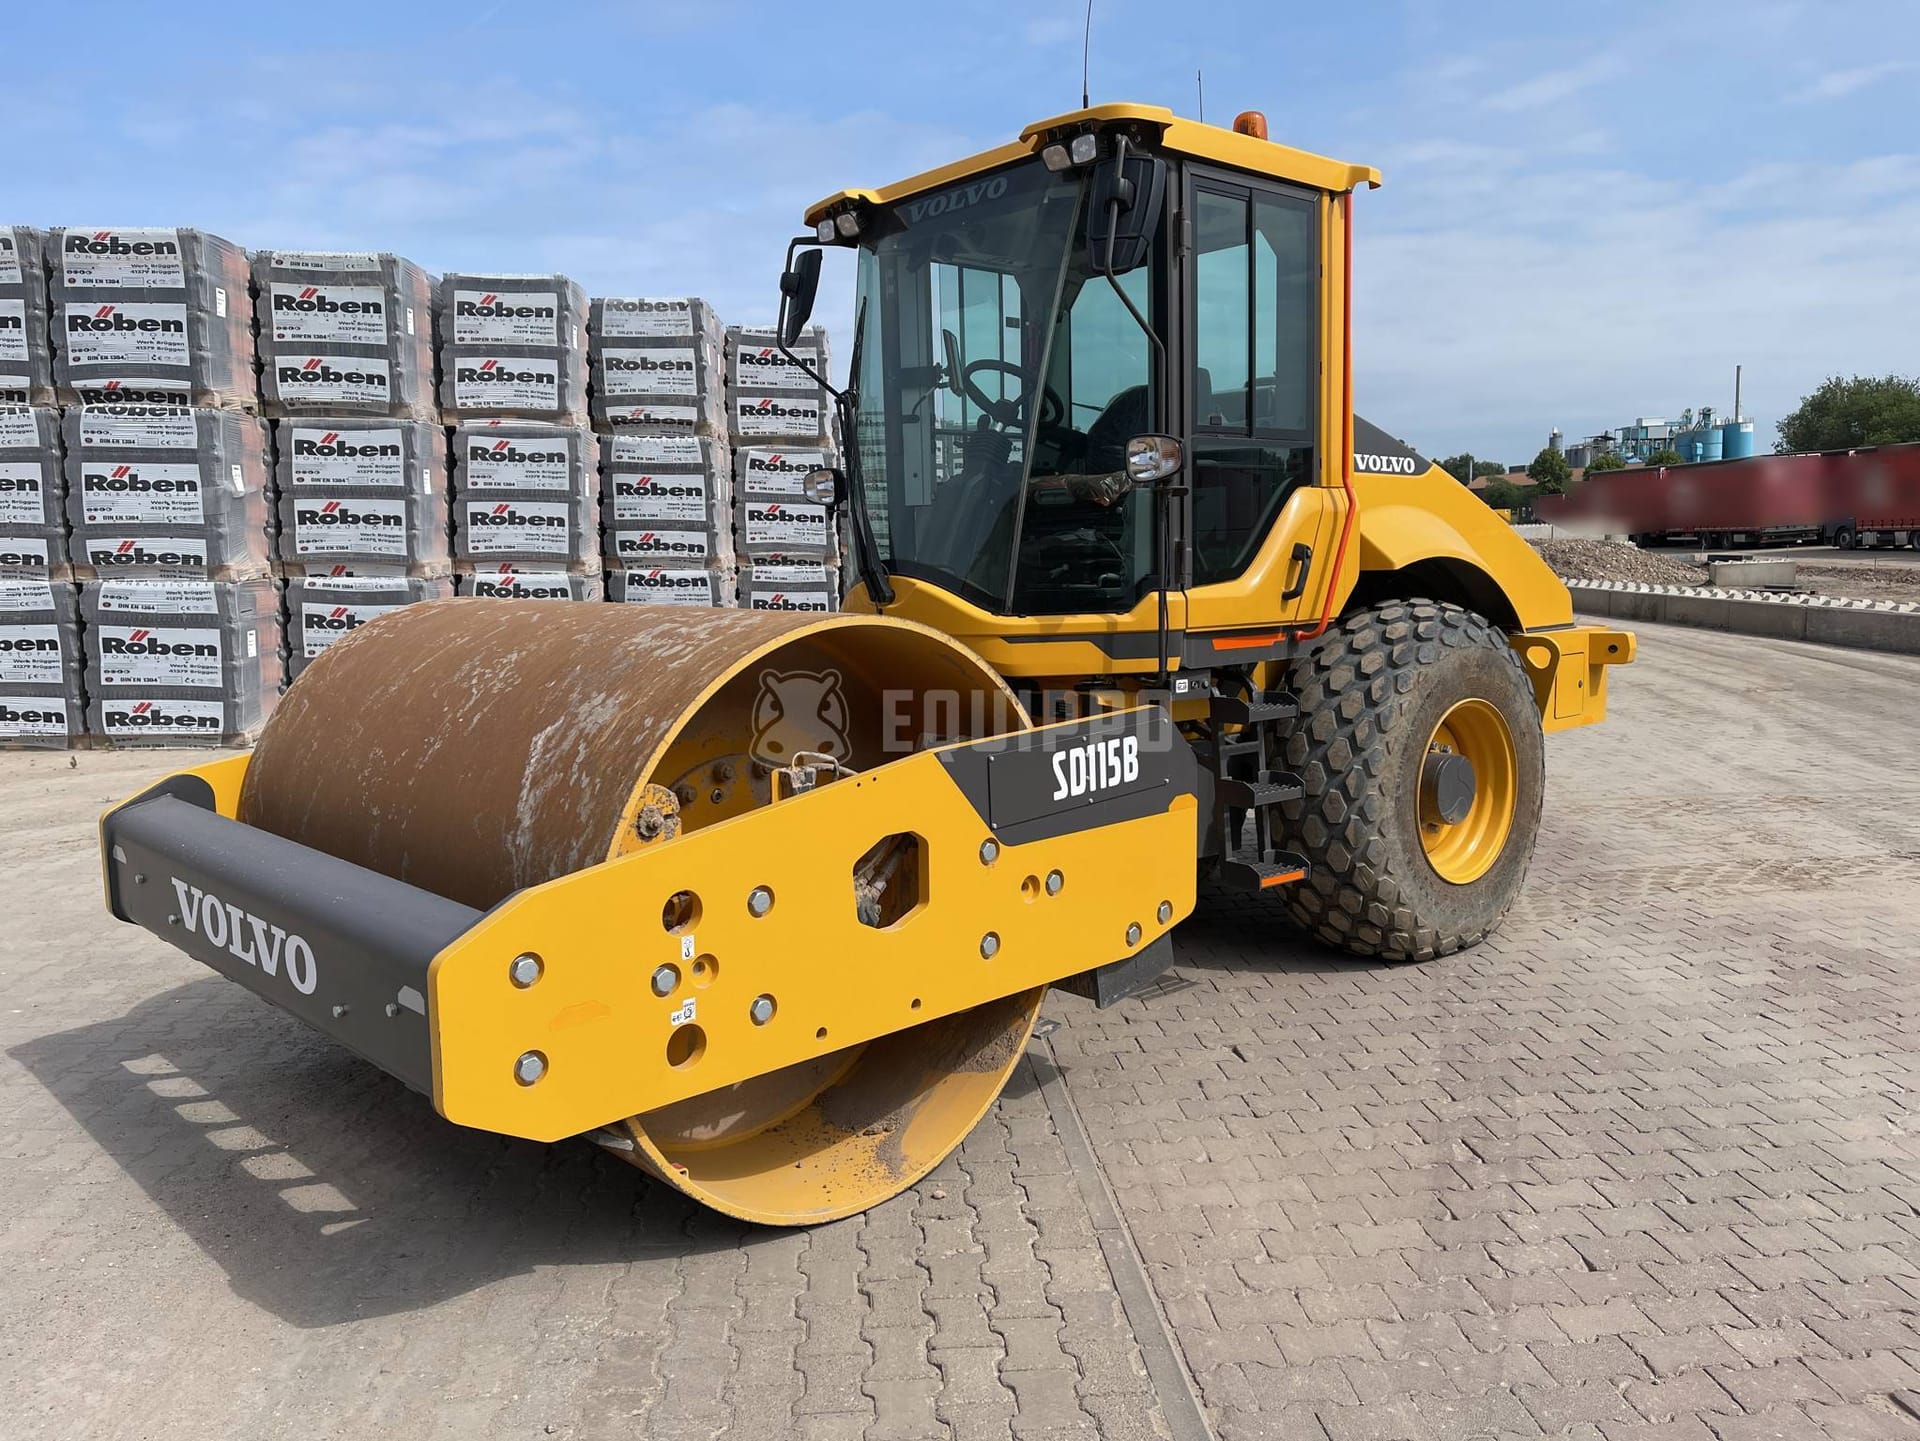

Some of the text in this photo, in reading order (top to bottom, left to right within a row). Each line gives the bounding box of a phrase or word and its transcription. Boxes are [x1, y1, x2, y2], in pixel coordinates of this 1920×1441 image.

[907, 177, 1008, 224] VOLVO
[65, 232, 176, 255] Röben
[273, 287, 382, 313] Röben
[457, 294, 553, 318] Röben
[68, 305, 183, 333] Röben
[278, 358, 386, 386] Röben
[457, 359, 555, 384] Röben
[79, 381, 188, 405] Röben
[740, 399, 817, 418] Röben
[294, 432, 400, 456] Röben
[470, 440, 565, 463] Röben
[1353, 453, 1415, 473] VOLVO
[84, 465, 198, 492] Röben
[616, 477, 702, 497] Röben
[297, 501, 402, 526] Röben
[470, 504, 565, 527] Röben
[748, 505, 824, 523] Röben
[90, 540, 203, 566] Röben
[619, 533, 704, 553] Röben
[475, 576, 569, 599] Röben
[628, 570, 707, 587] Röben
[753, 594, 826, 611] Röben
[304, 607, 367, 630] Röb
[0, 638, 58, 651] ben
[102, 630, 217, 656] Röben
[0, 705, 65, 724] ben
[105, 702, 219, 728] Röben
[1052, 735, 1139, 801] SD115B
[170, 876, 317, 995] VOLVO
